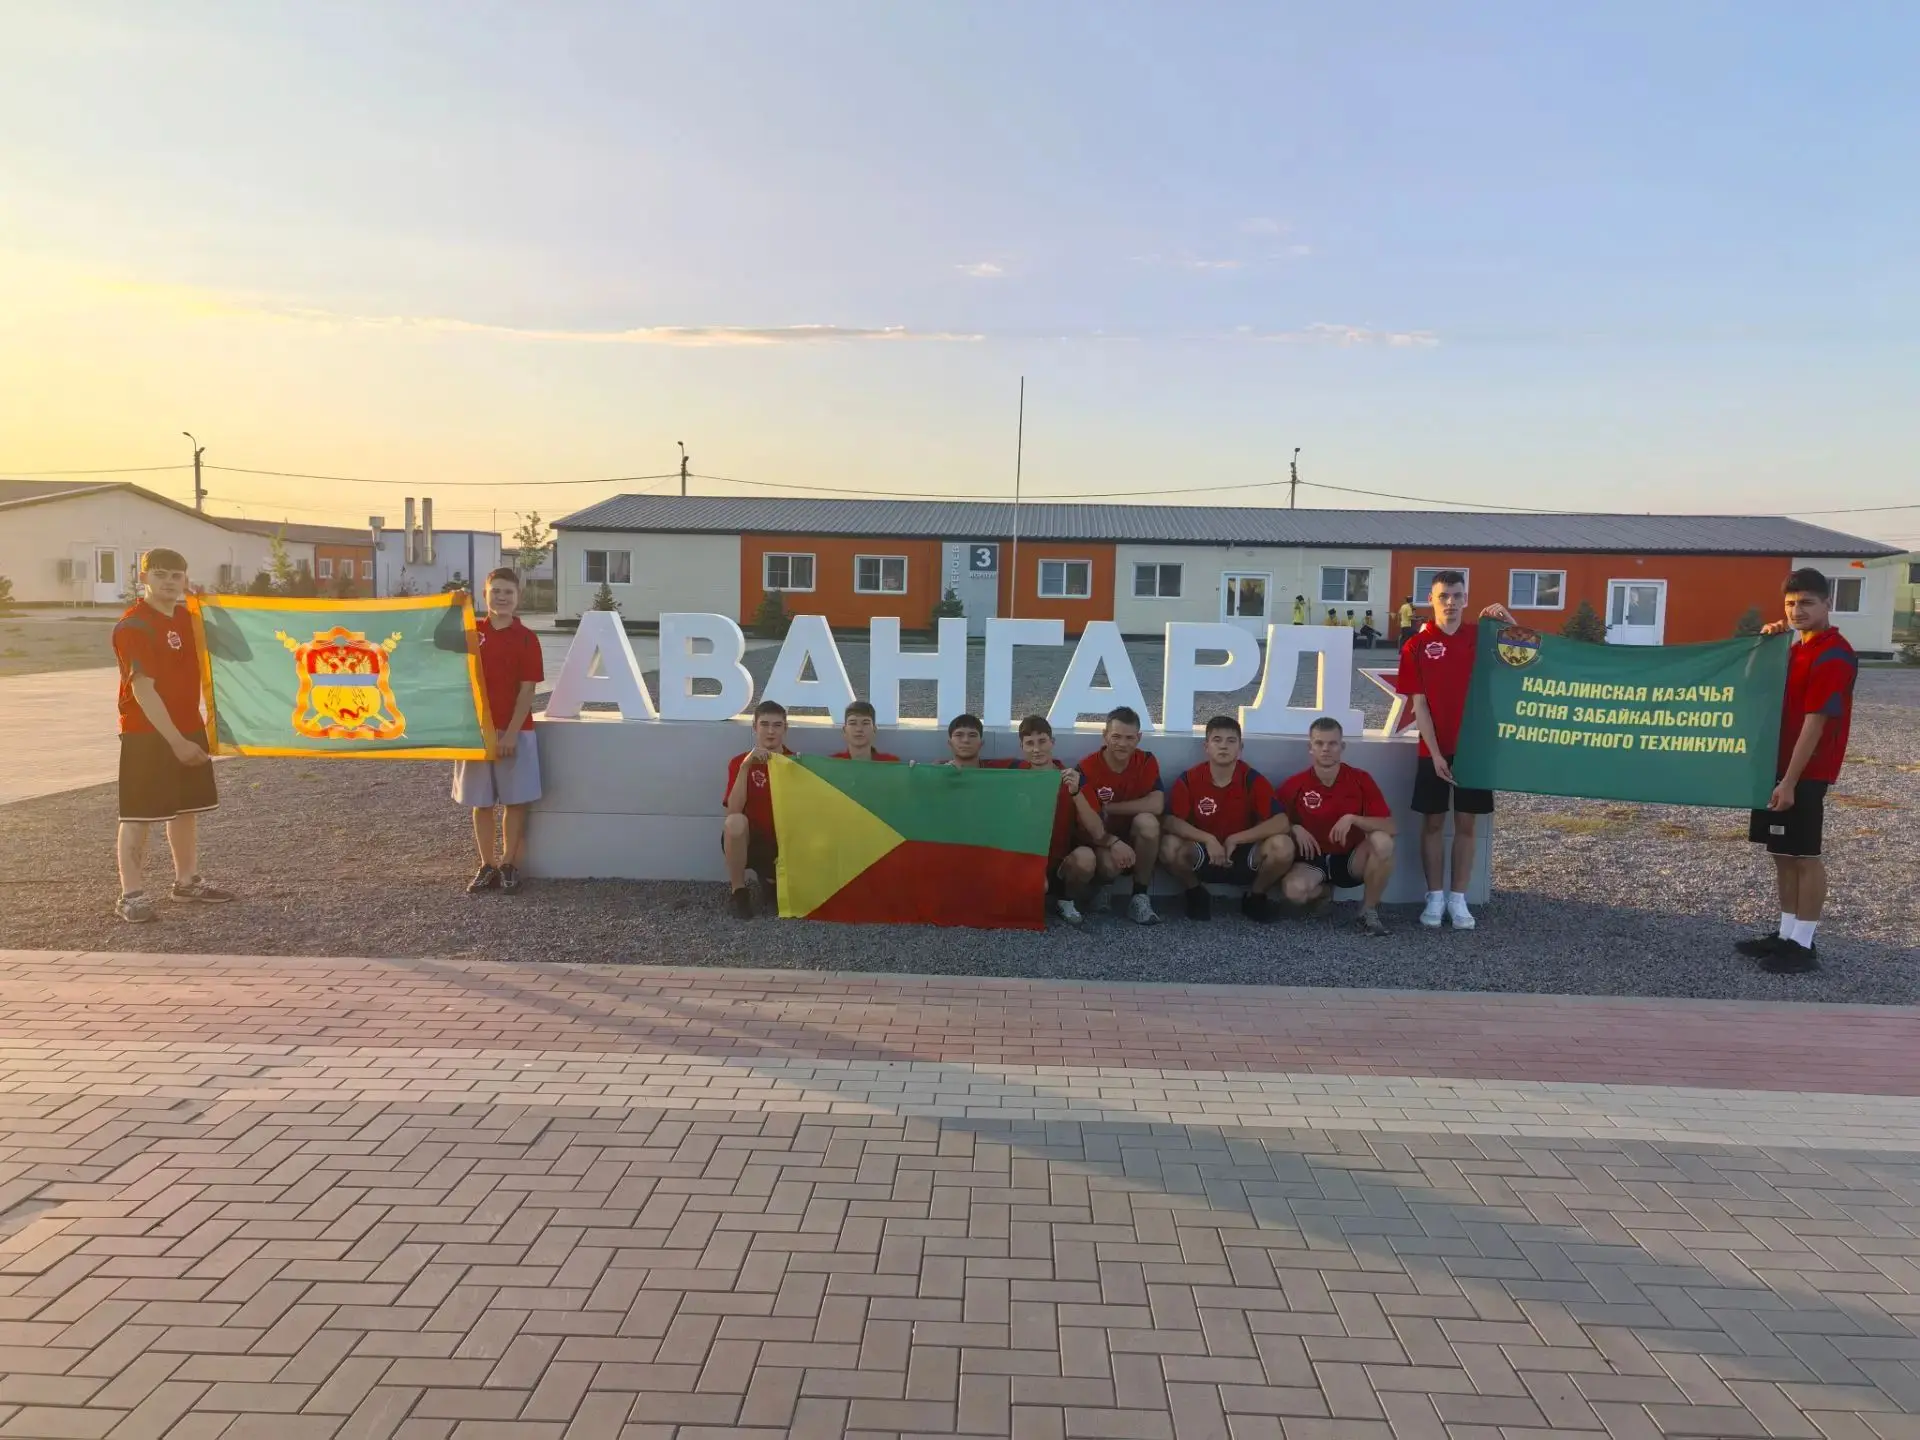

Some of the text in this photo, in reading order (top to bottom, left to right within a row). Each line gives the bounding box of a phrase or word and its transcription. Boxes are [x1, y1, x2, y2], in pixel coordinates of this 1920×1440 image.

[976, 548, 991, 567] 3
[545, 611, 1365, 737] АВАНГАРД
[1522, 677, 1734, 702] КАДАЛИНСКАЯ КАЗАЧЬЯ
[1515, 700, 1734, 728] СОТНЯ ЗАБАЙКАЛЬСКОГО
[1498, 722, 1747, 753] ТРАНСПОРТНОГО ТЕХНИКУМА
